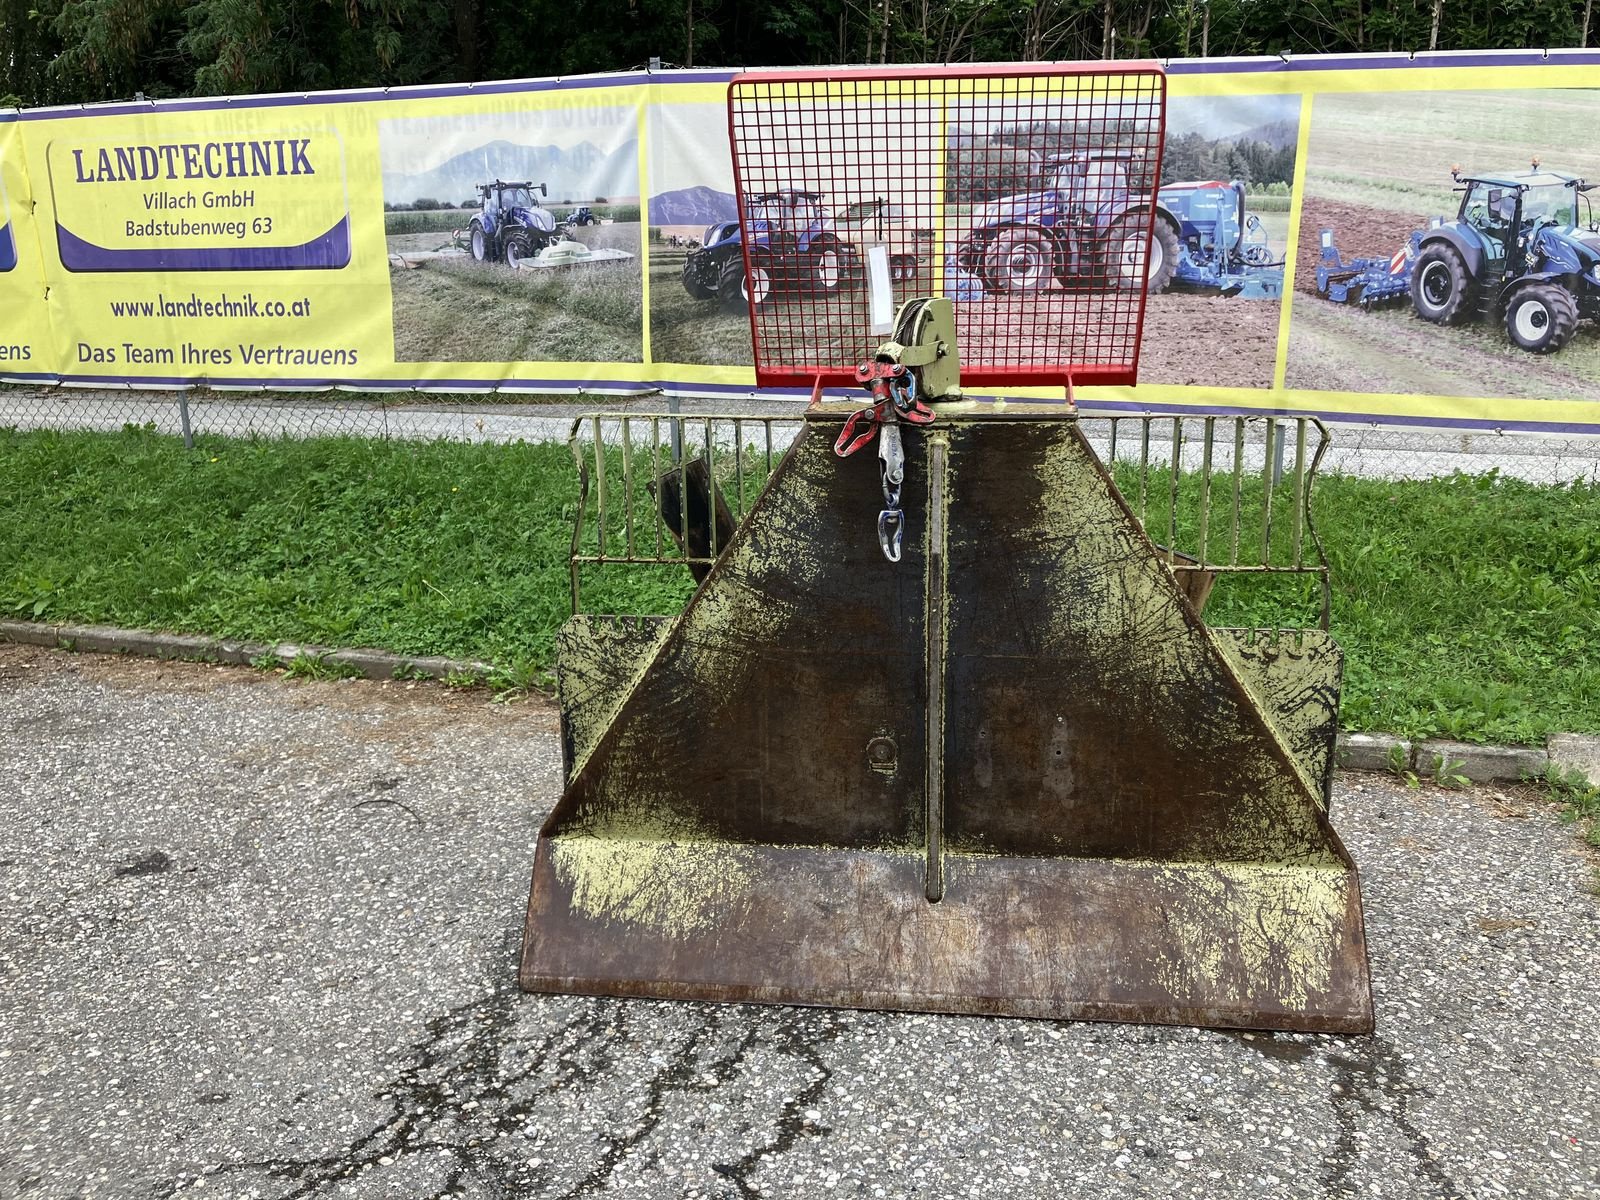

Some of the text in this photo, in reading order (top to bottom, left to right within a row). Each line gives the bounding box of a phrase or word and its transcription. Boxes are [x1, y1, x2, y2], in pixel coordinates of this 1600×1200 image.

[72, 139, 315, 183] LANDTECHNIK
[143, 189, 255, 211] Villach GmbH
[126, 217, 272, 239] Badstubenweg 63
[110, 293, 311, 317] www.landtechnik.co.at
[77, 342, 358, 365] Das Team Ihres Vertrauens
